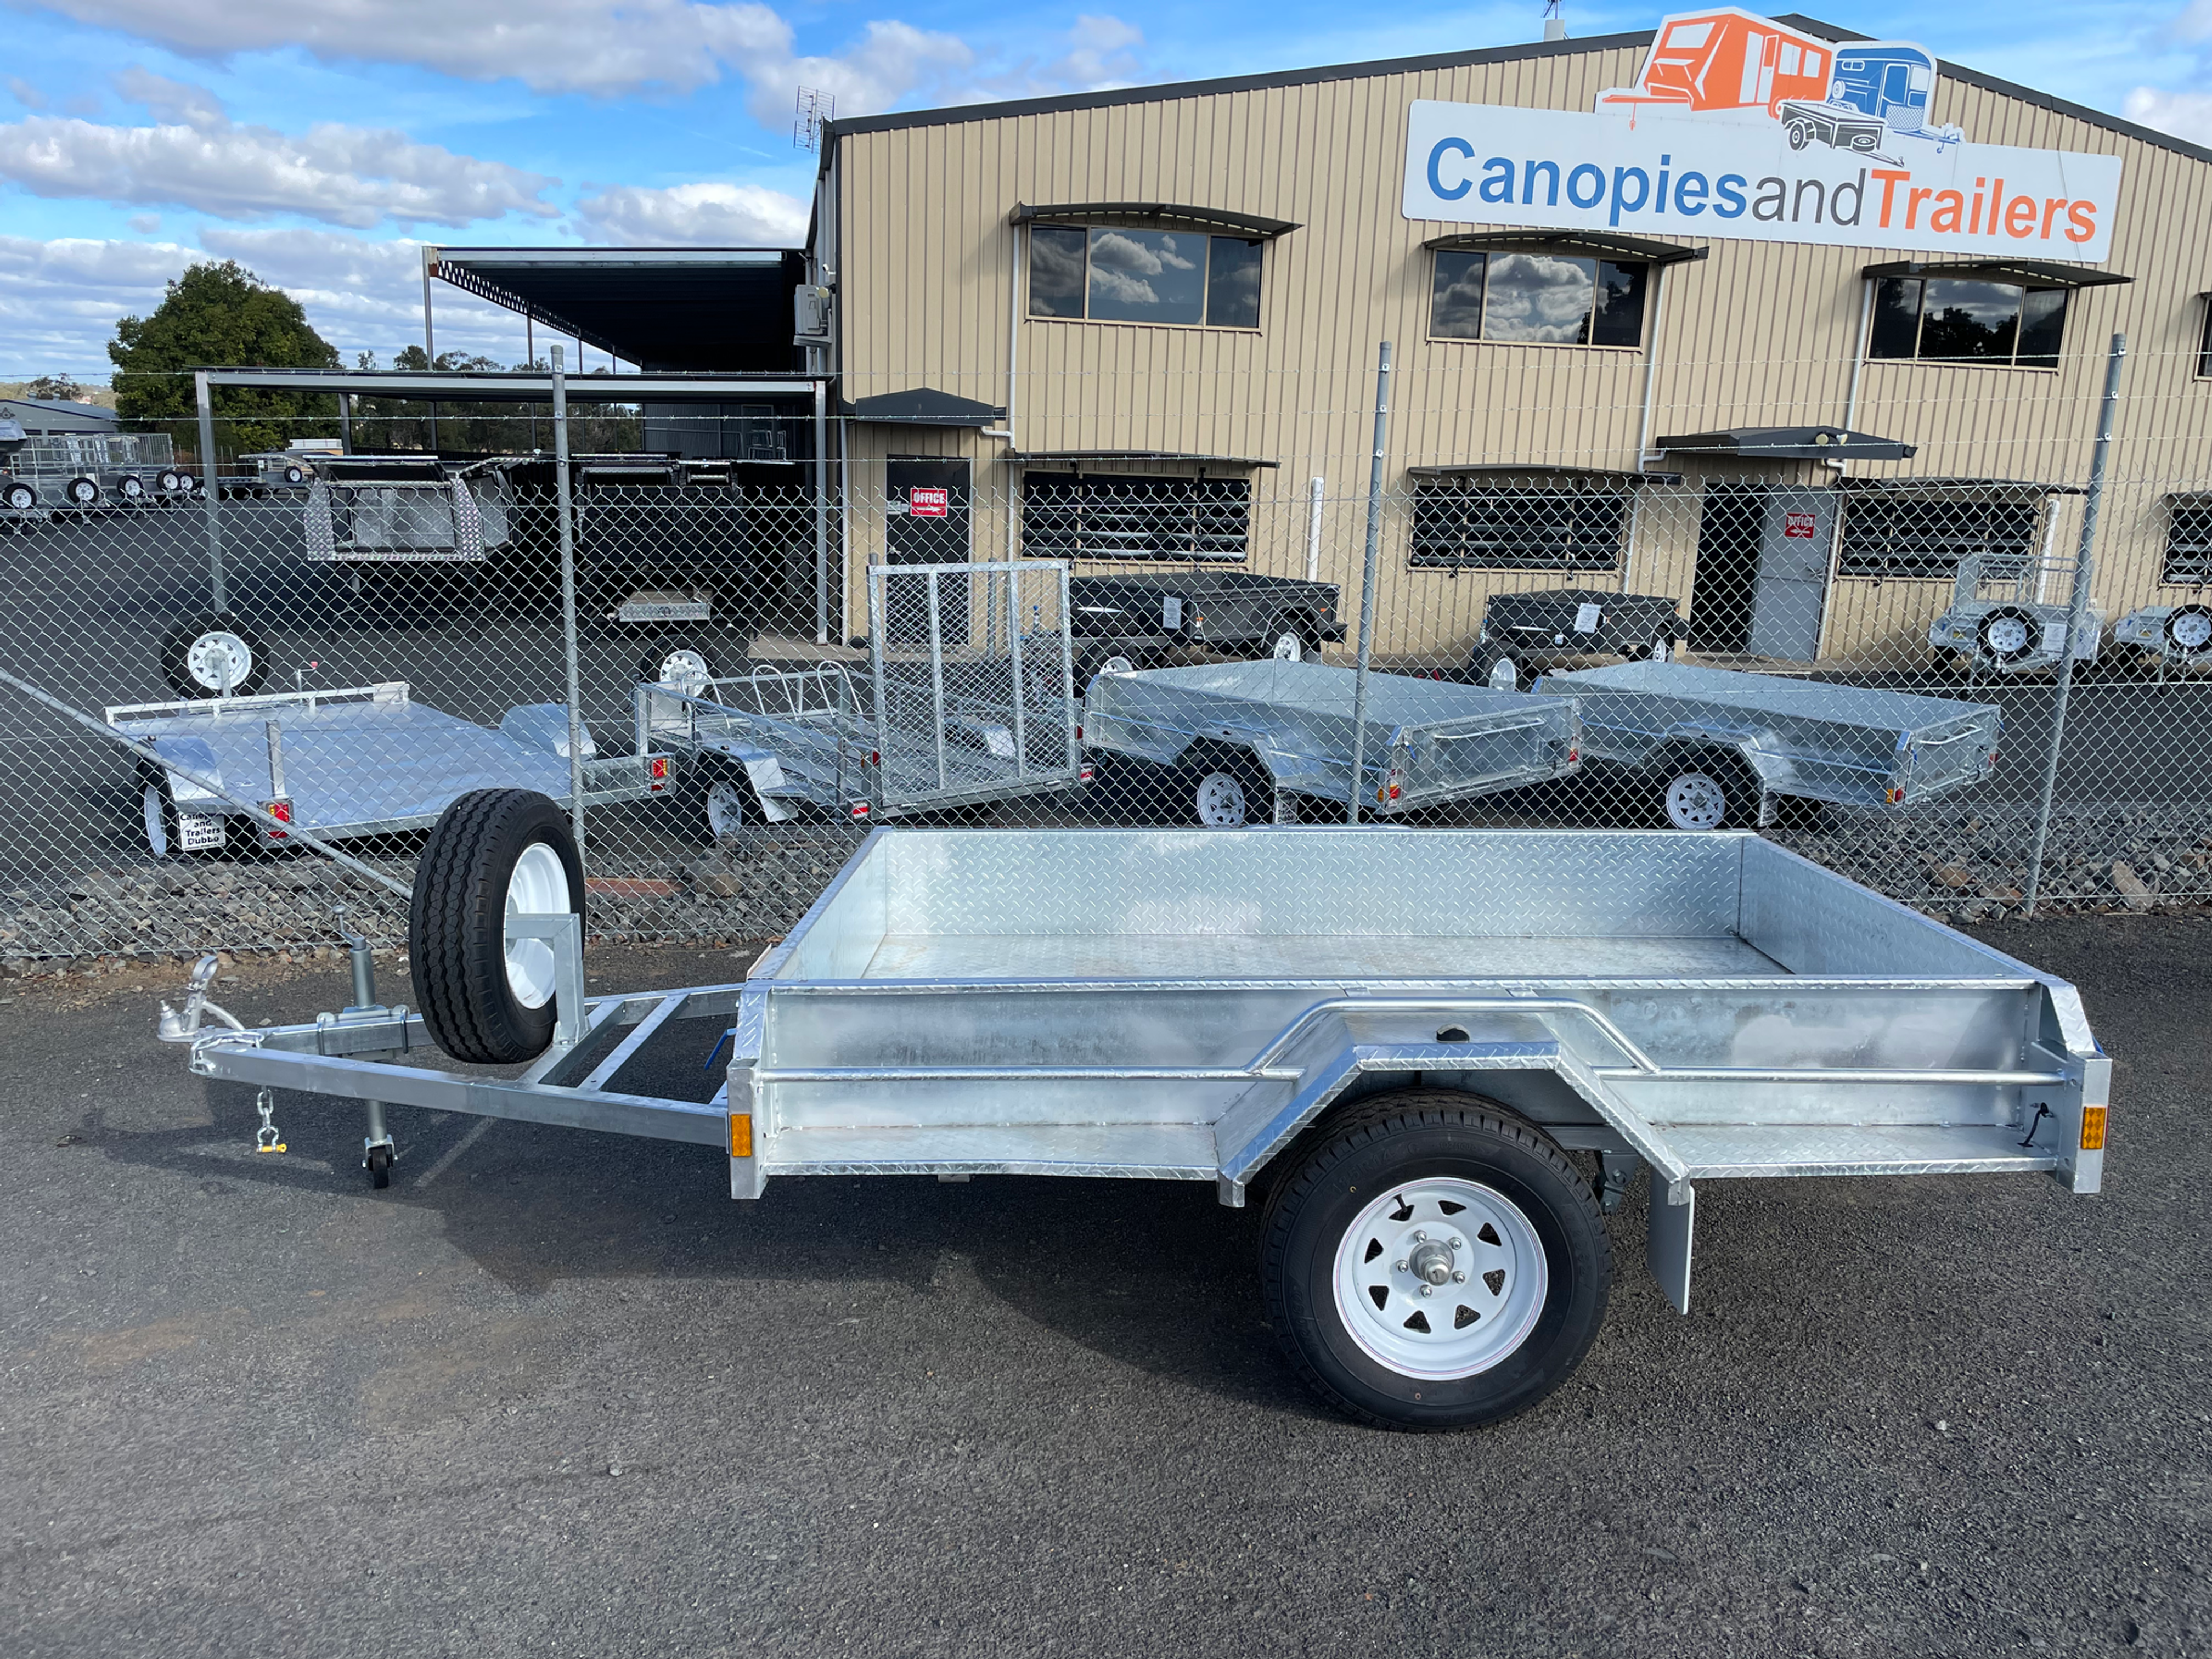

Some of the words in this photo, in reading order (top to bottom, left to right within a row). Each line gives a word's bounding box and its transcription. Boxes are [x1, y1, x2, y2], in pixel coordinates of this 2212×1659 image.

[913, 492, 945, 504] OFFICE
[194, 819, 212, 828] and
[185, 827, 221, 837] Trailers
[188, 836, 219, 845] Dubbo
